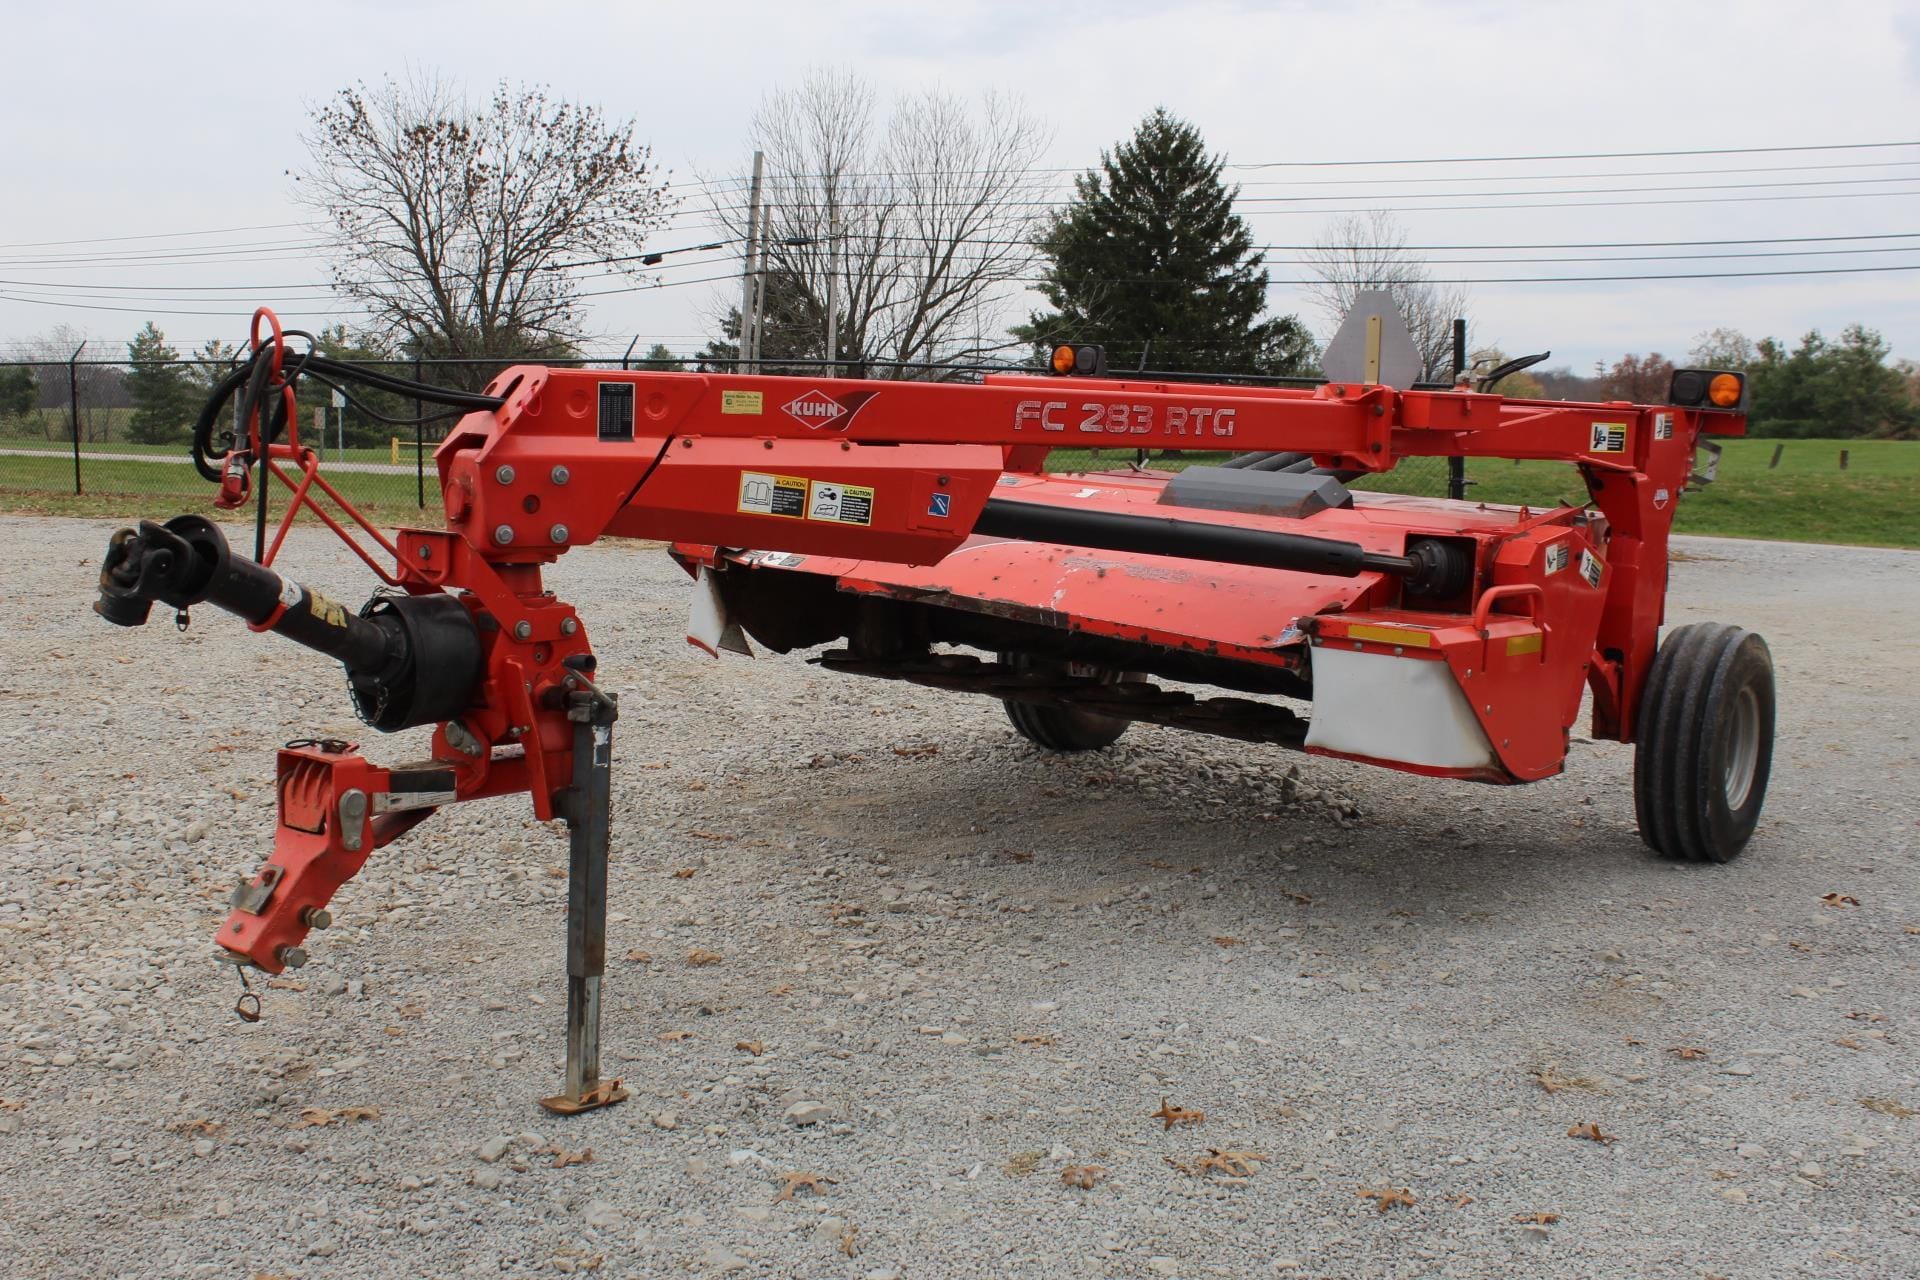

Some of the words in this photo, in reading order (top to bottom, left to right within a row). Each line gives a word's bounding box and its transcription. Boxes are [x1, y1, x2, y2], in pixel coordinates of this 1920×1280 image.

[791, 401, 838, 417] KUHN
[1014, 400, 1067, 431] FC
[1079, 403, 1153, 433] 283
[1164, 406, 1236, 436] RTG
[781, 479, 805, 488] CAUTION
[849, 489, 872, 497] CAUTION
